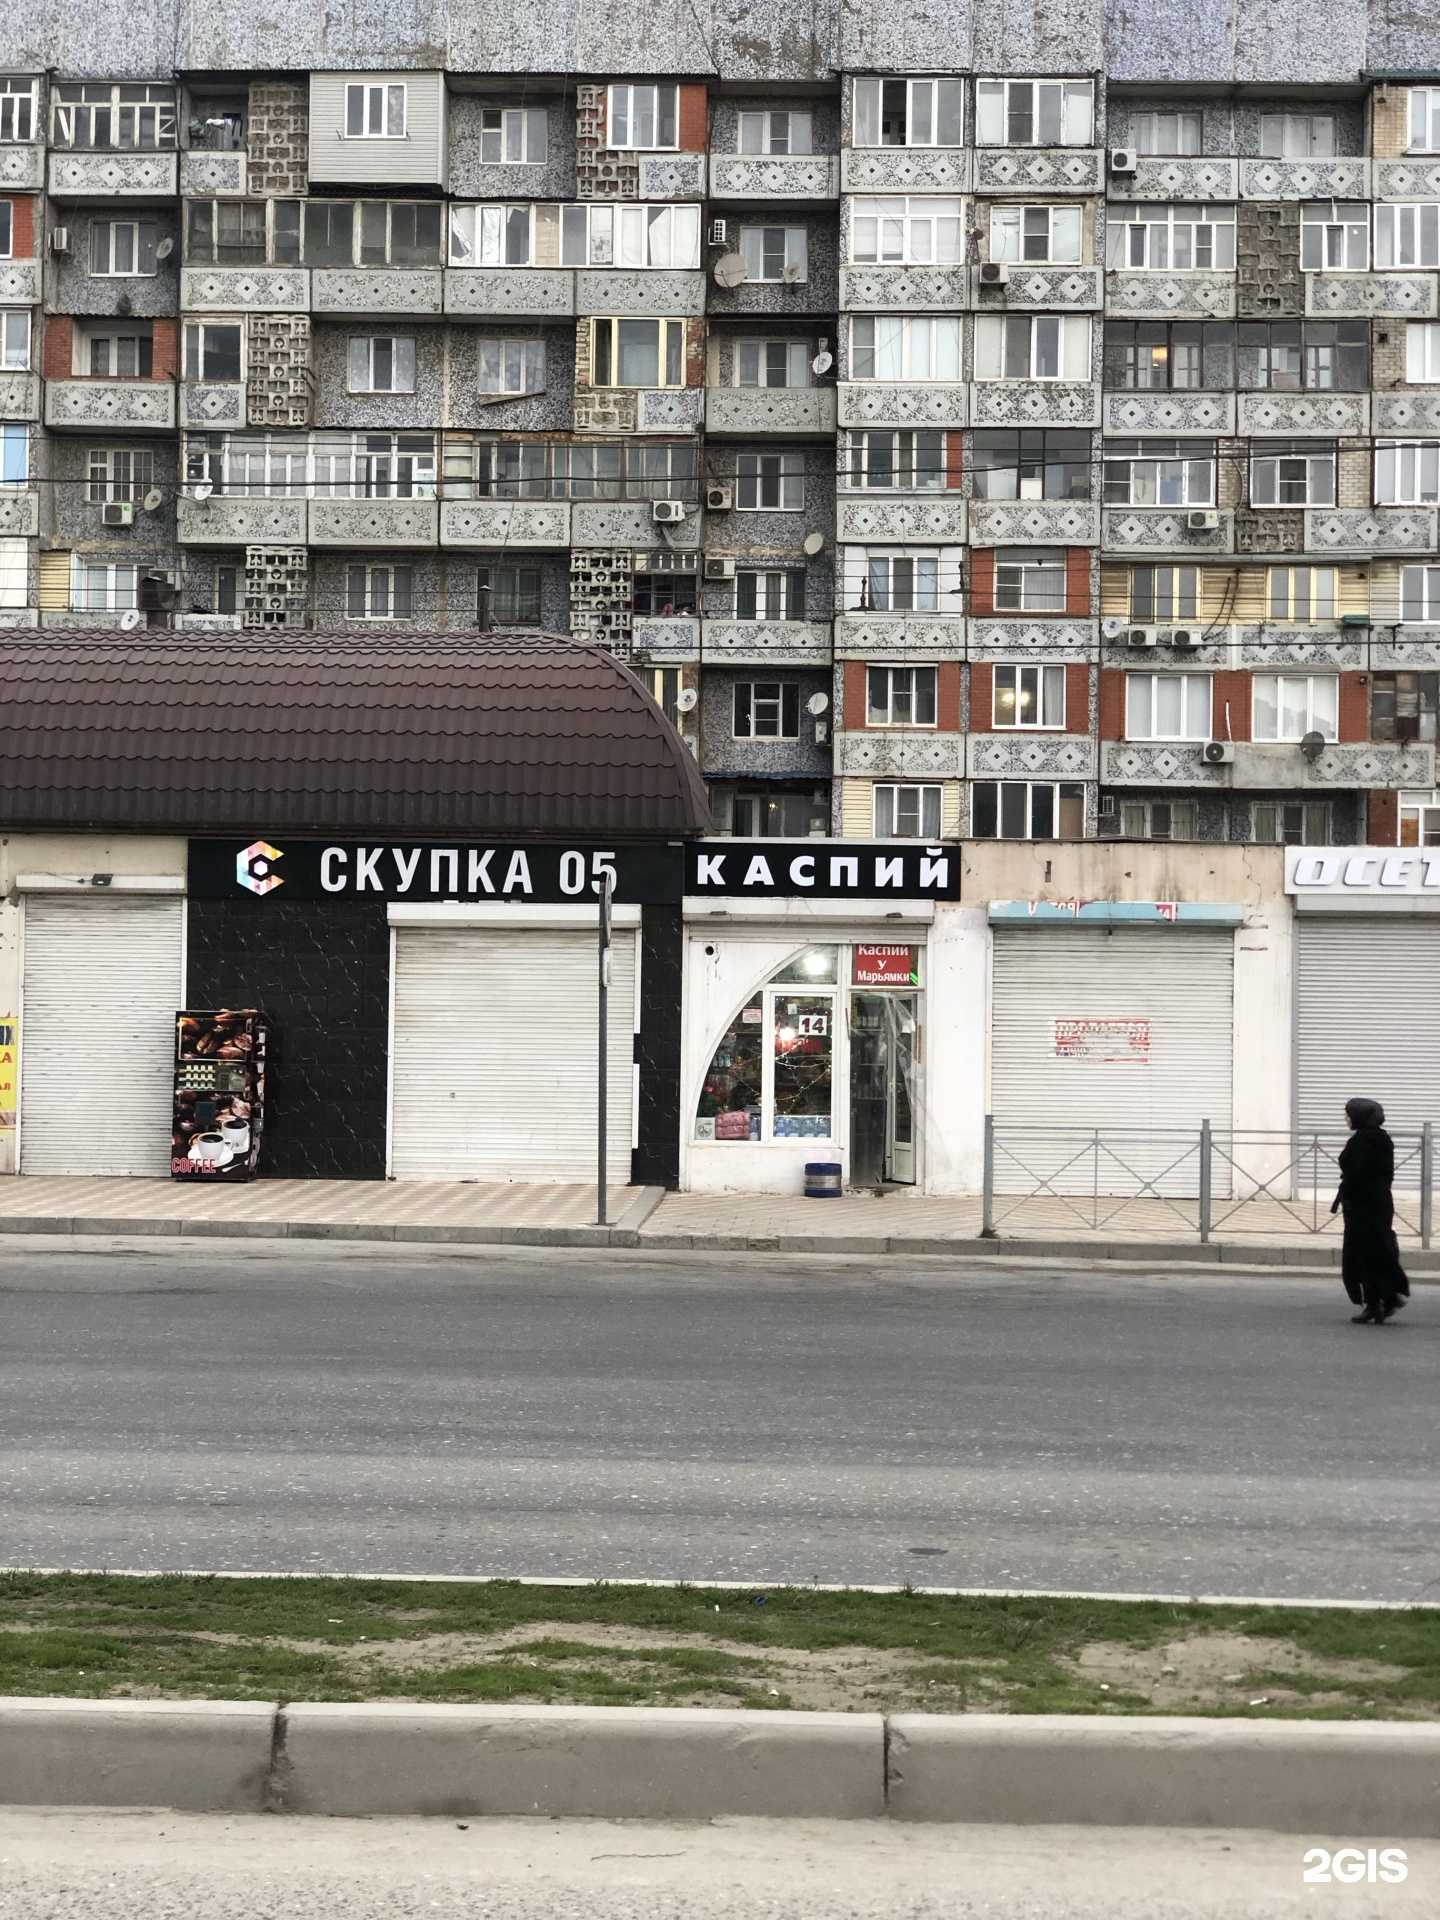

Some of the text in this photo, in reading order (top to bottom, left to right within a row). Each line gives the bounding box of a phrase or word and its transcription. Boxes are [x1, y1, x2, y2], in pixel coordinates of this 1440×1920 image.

[320, 846, 617, 895] СКУПКА 05
[696, 847, 949, 888] КАСПИЙ
[857, 970, 910, 983] Марьямки
[801, 1018, 825, 1033] 14
[171, 1157, 217, 1174] COFFEE
